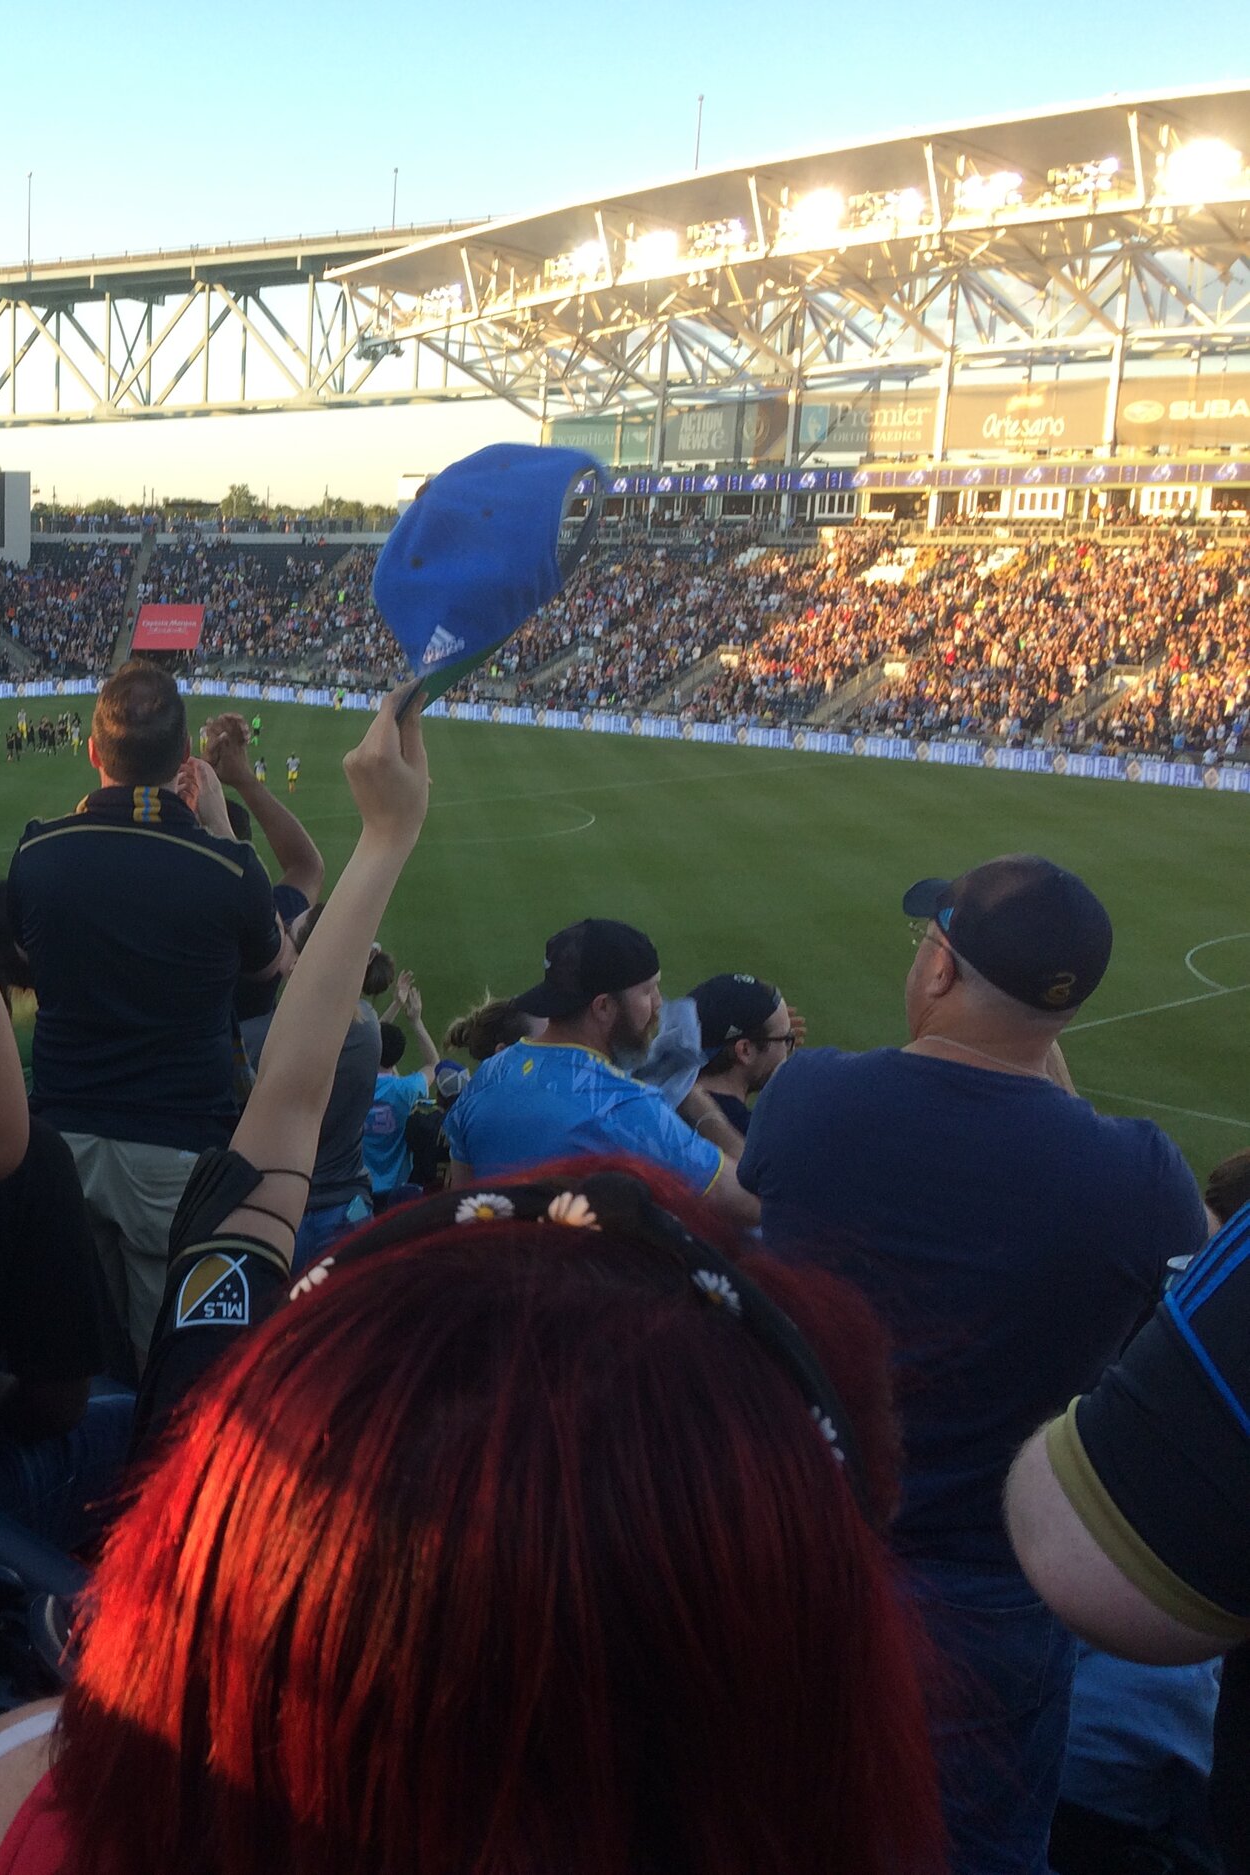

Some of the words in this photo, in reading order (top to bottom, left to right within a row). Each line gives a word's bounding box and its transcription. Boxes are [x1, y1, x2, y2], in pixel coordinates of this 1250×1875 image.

[835, 402, 931, 427] Premier
[1169, 399, 1250, 420] SUBA
[681, 411, 724, 432] ACTION
[678, 432, 709, 450] NEWS
[203, 1301, 243, 1318] MLS
